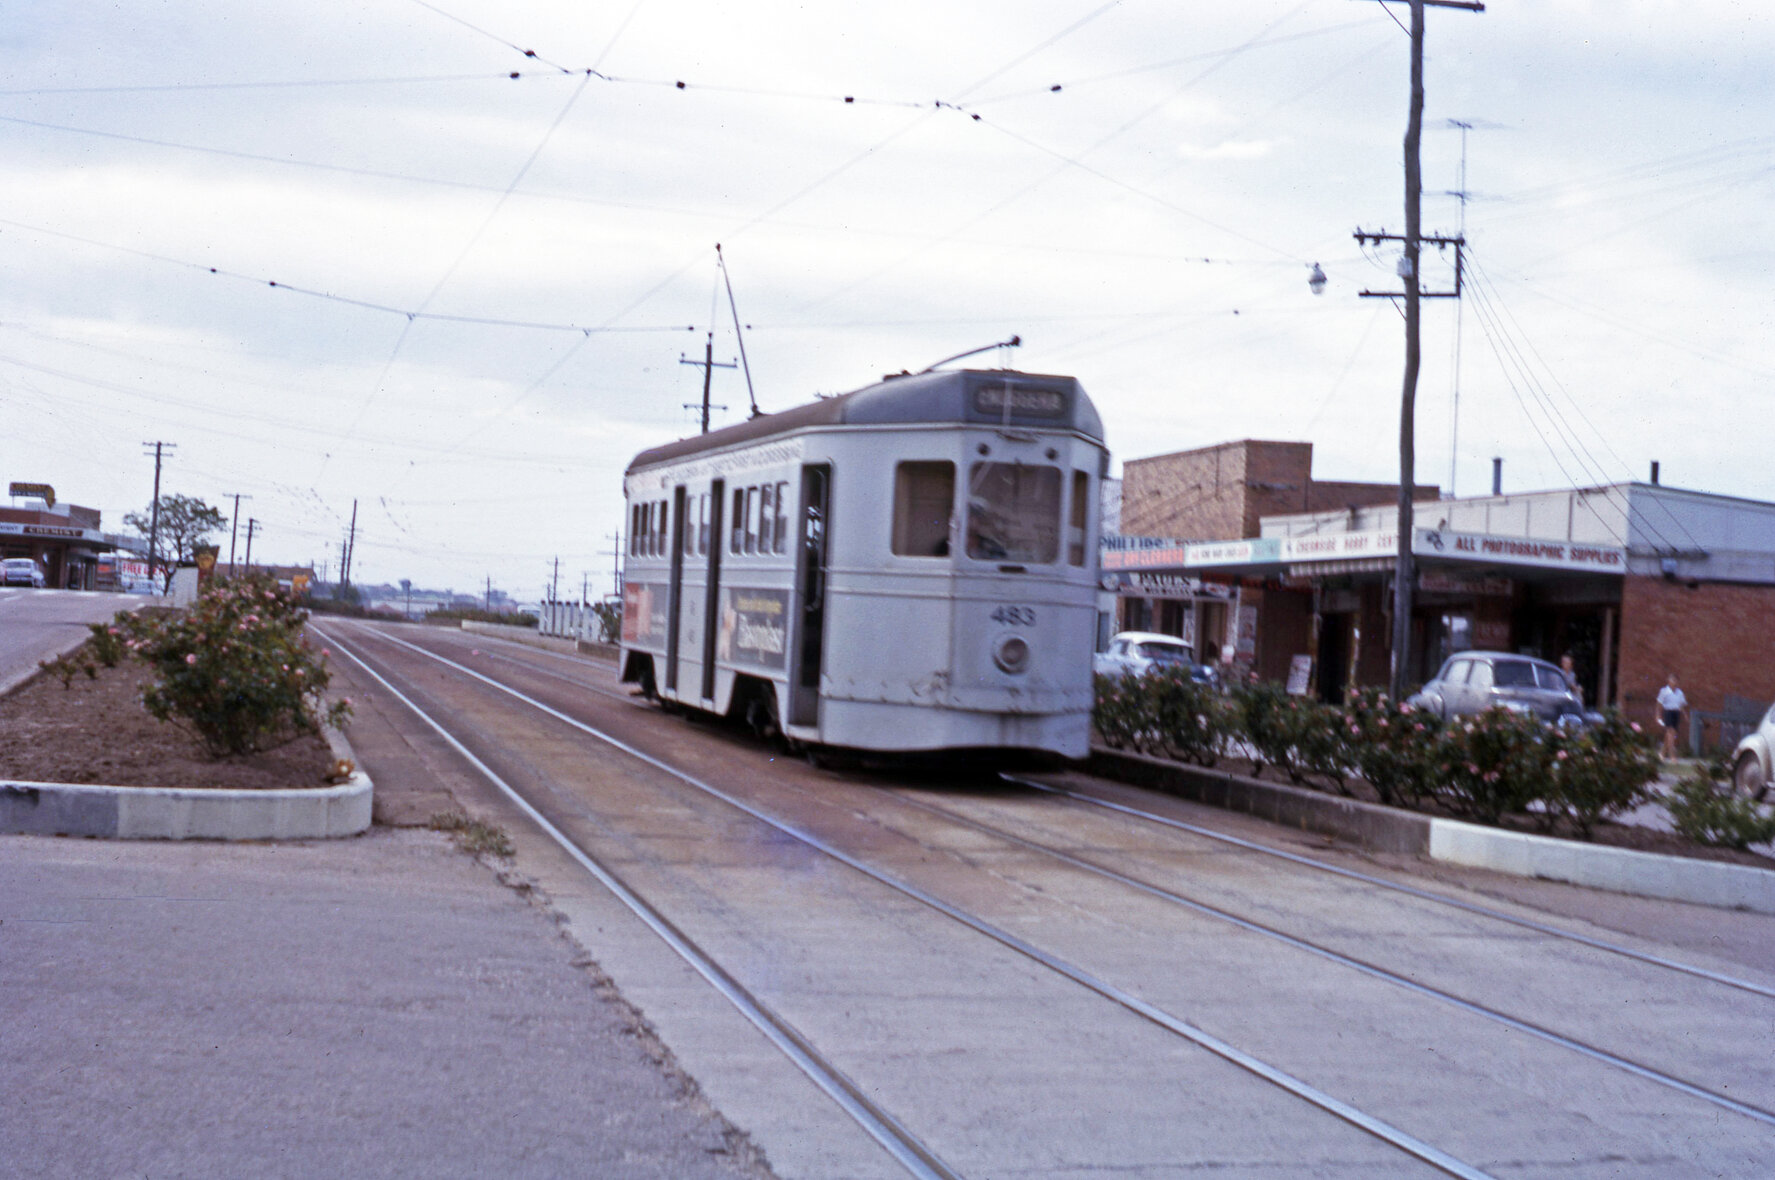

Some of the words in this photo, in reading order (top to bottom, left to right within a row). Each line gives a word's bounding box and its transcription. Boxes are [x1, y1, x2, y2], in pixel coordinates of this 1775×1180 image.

[28, 525, 77, 536] CHEMIST
[1455, 536, 1477, 551] ALL
[1482, 539, 1564, 560] PHOTOGRAPHIC
[1570, 546, 1619, 565] SUPPLIES
[990, 606, 1036, 627] 483
